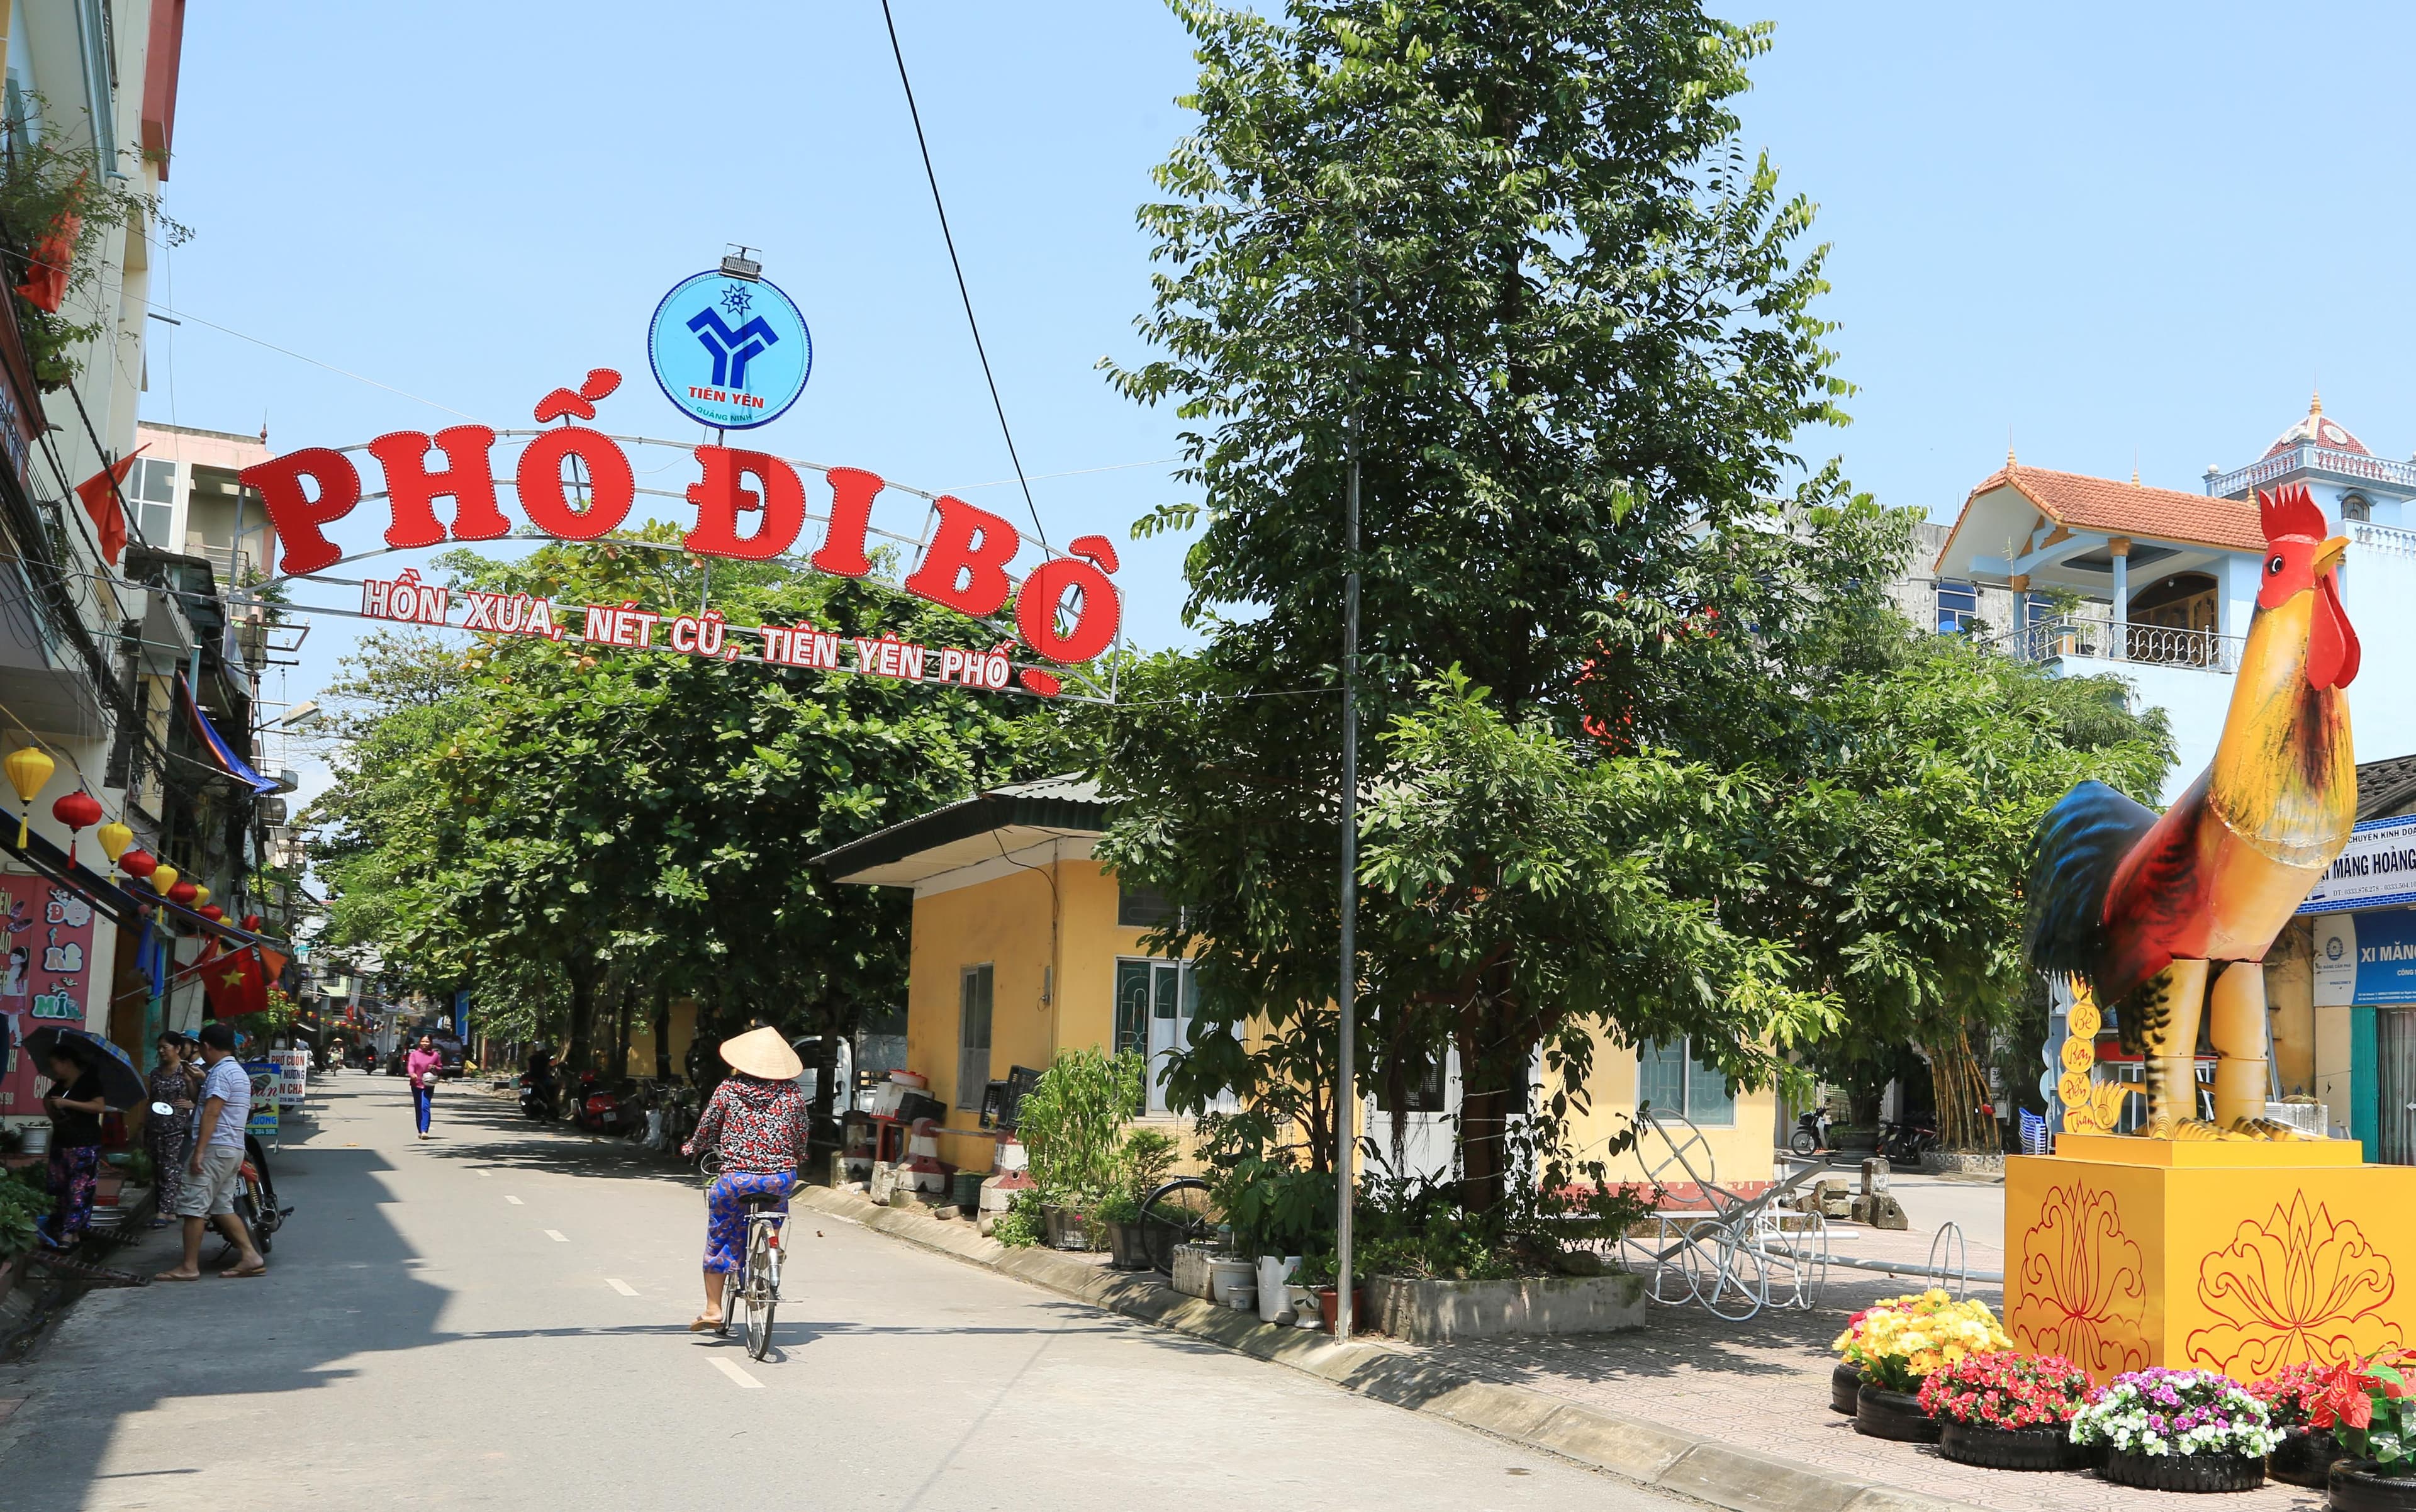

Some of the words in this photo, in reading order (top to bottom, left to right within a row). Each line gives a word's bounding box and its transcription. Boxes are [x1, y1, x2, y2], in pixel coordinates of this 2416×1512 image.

[688, 387, 725, 402] TIÊN
[732, 393, 764, 408] YÊN
[696, 406, 728, 420] QUẢNG
[238, 369, 634, 575] PHỐ
[683, 445, 885, 578] ĐI
[905, 495, 1120, 697] BỘ
[362, 568, 449, 625] HỒN
[461, 590, 565, 642] XƯA,
[584, 600, 659, 649] NÉT
[669, 610, 741, 661] CŨ,
[761, 620, 839, 670] TIÊN
[855, 631, 925, 681] YÊN
[939, 640, 1017, 690] PHỐ
[2381, 829, 2399, 839] KINH
[2373, 846, 2416, 874] HOÀNG
[2361, 947, 2376, 963] XI
[2380, 941, 2416, 961] MĂN
